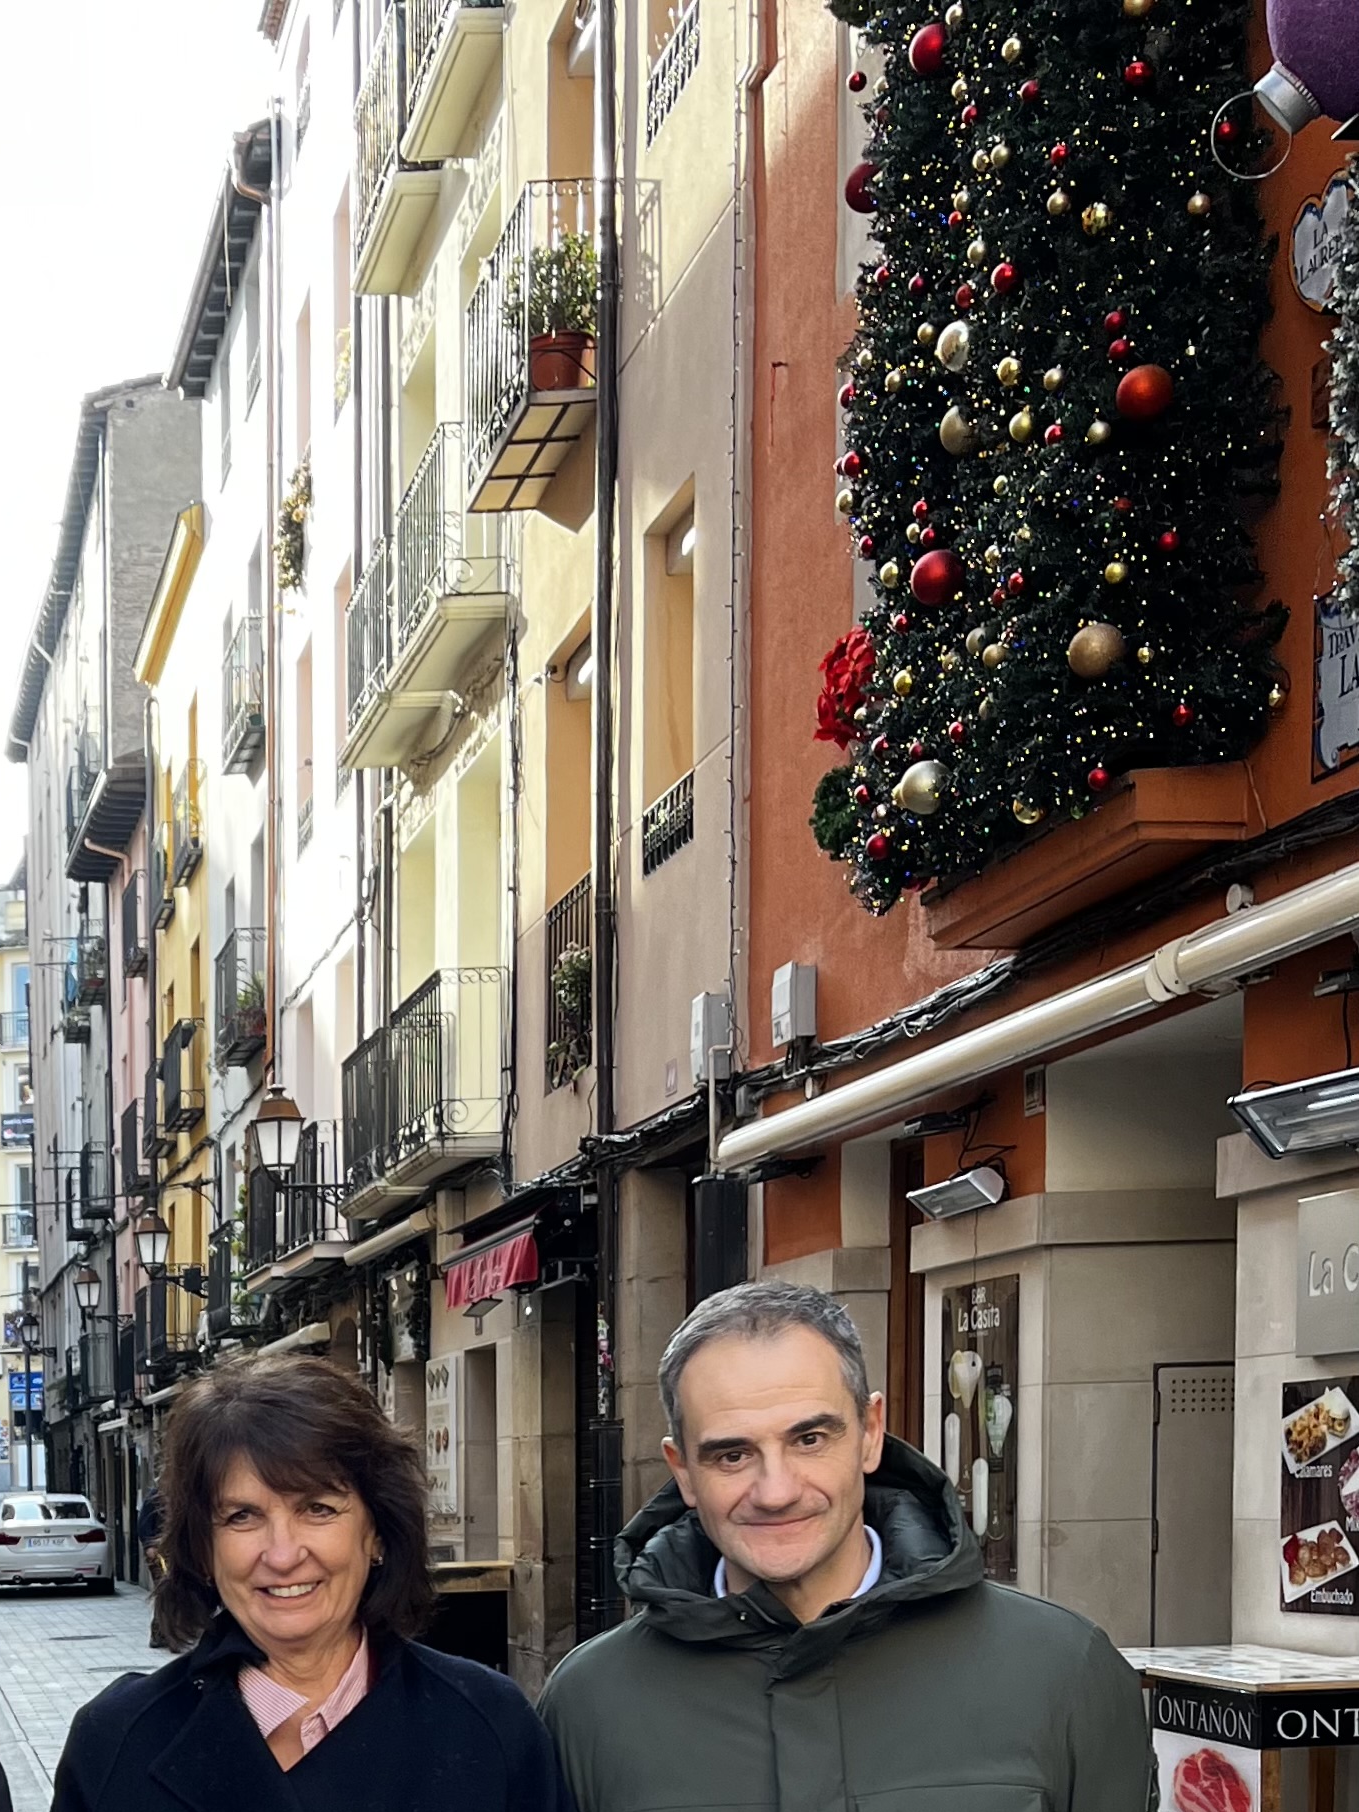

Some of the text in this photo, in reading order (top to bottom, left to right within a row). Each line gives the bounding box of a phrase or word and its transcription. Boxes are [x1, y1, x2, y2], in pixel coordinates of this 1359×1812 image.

[1308, 1251, 1334, 1297] La
[972, 1287, 987, 1305] BAR
[957, 1303, 1001, 1332] La Casita
[1310, 1588, 1354, 1605] Embuchado
[1158, 1695, 1252, 1741] ONTAÑÓN
